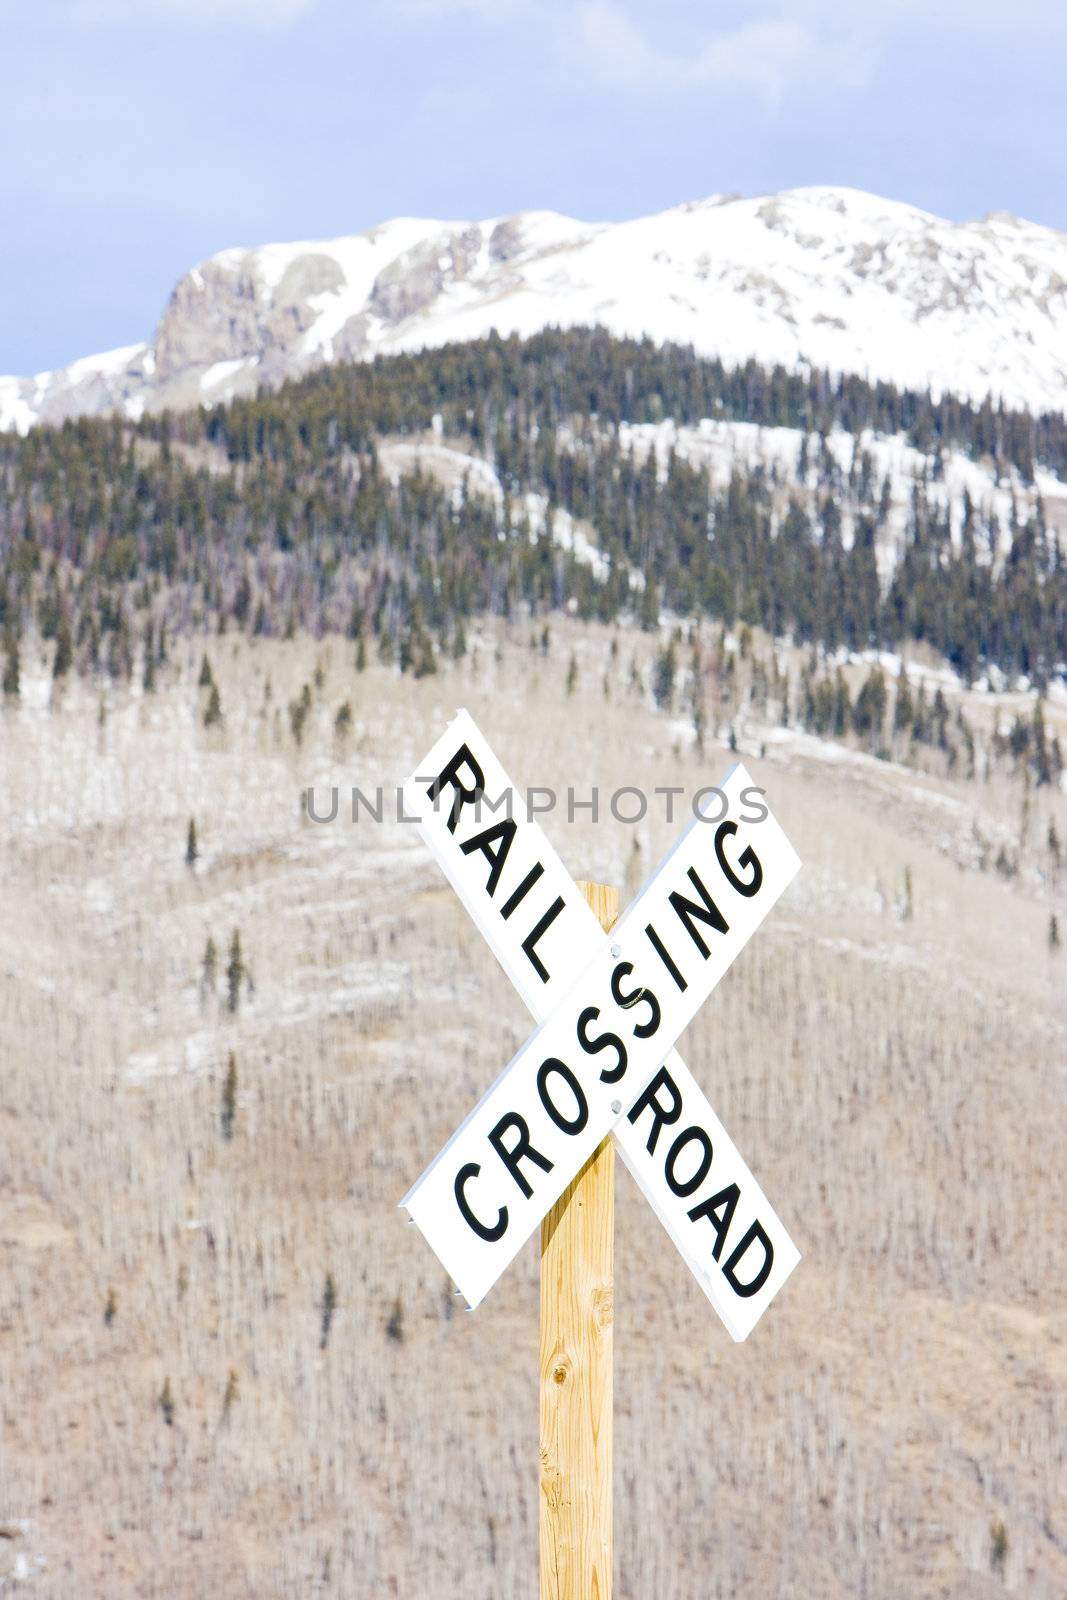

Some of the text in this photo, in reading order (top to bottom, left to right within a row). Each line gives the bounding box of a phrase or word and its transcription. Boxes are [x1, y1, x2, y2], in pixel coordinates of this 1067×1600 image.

[426, 743, 774, 1298] RAIL ROAD
[454, 820, 763, 1243] CROSSING
